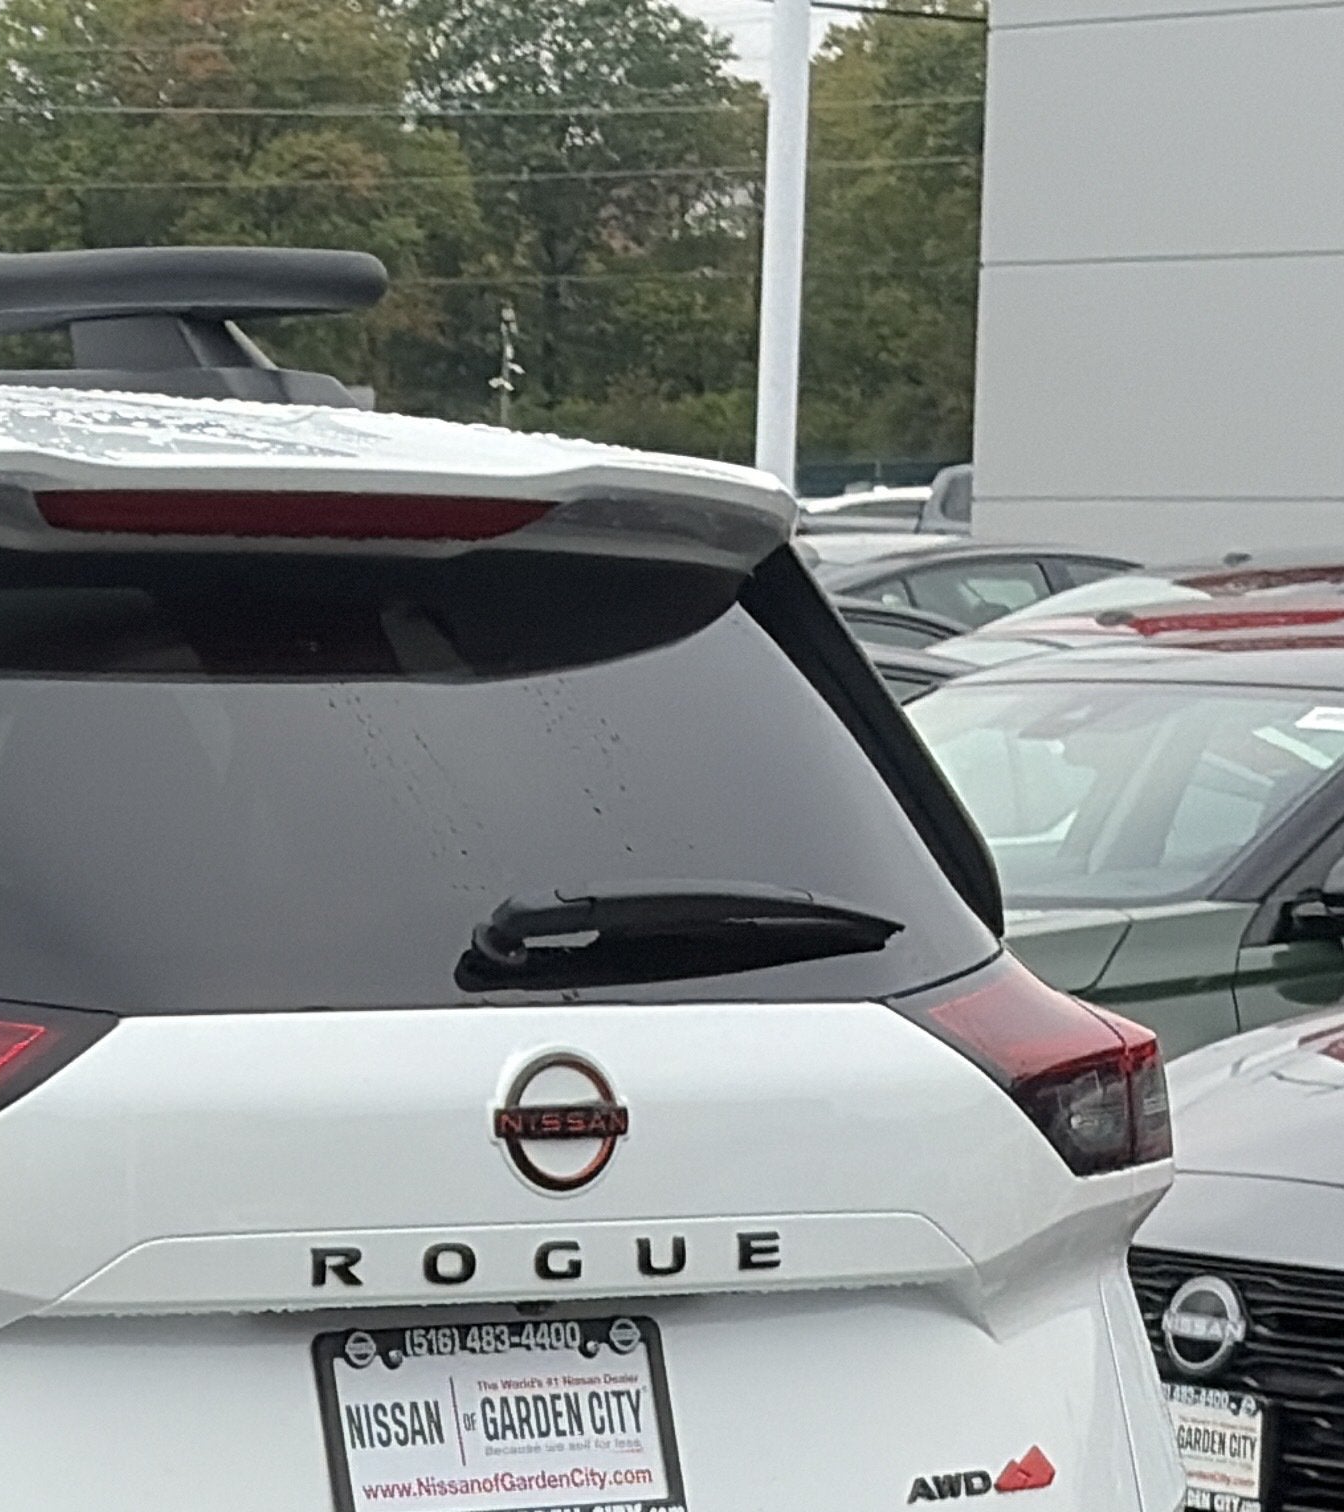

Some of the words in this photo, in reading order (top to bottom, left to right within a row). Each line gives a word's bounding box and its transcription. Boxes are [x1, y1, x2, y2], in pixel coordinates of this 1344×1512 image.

[500, 1110, 627, 1134] NISSAN
[310, 1230, 782, 1287] ROGUE
[404, 1328, 461, 1355] (516)
[465, 1321, 581, 1353] 483-4400
[1163, 1312, 1246, 1342] NISSAN
[344, 1400, 445, 1449] NISSAN
[463, 1413, 476, 1431] OF
[479, 1392, 585, 1441] GARDEN
[588, 1388, 643, 1435] CITY
[1177, 1424, 1226, 1456] GARDEN
[1229, 1434, 1257, 1460] CITY
[362, 1467, 653, 1500] www.NissanofGardenCity.com
[907, 1471, 992, 1504] AWD
